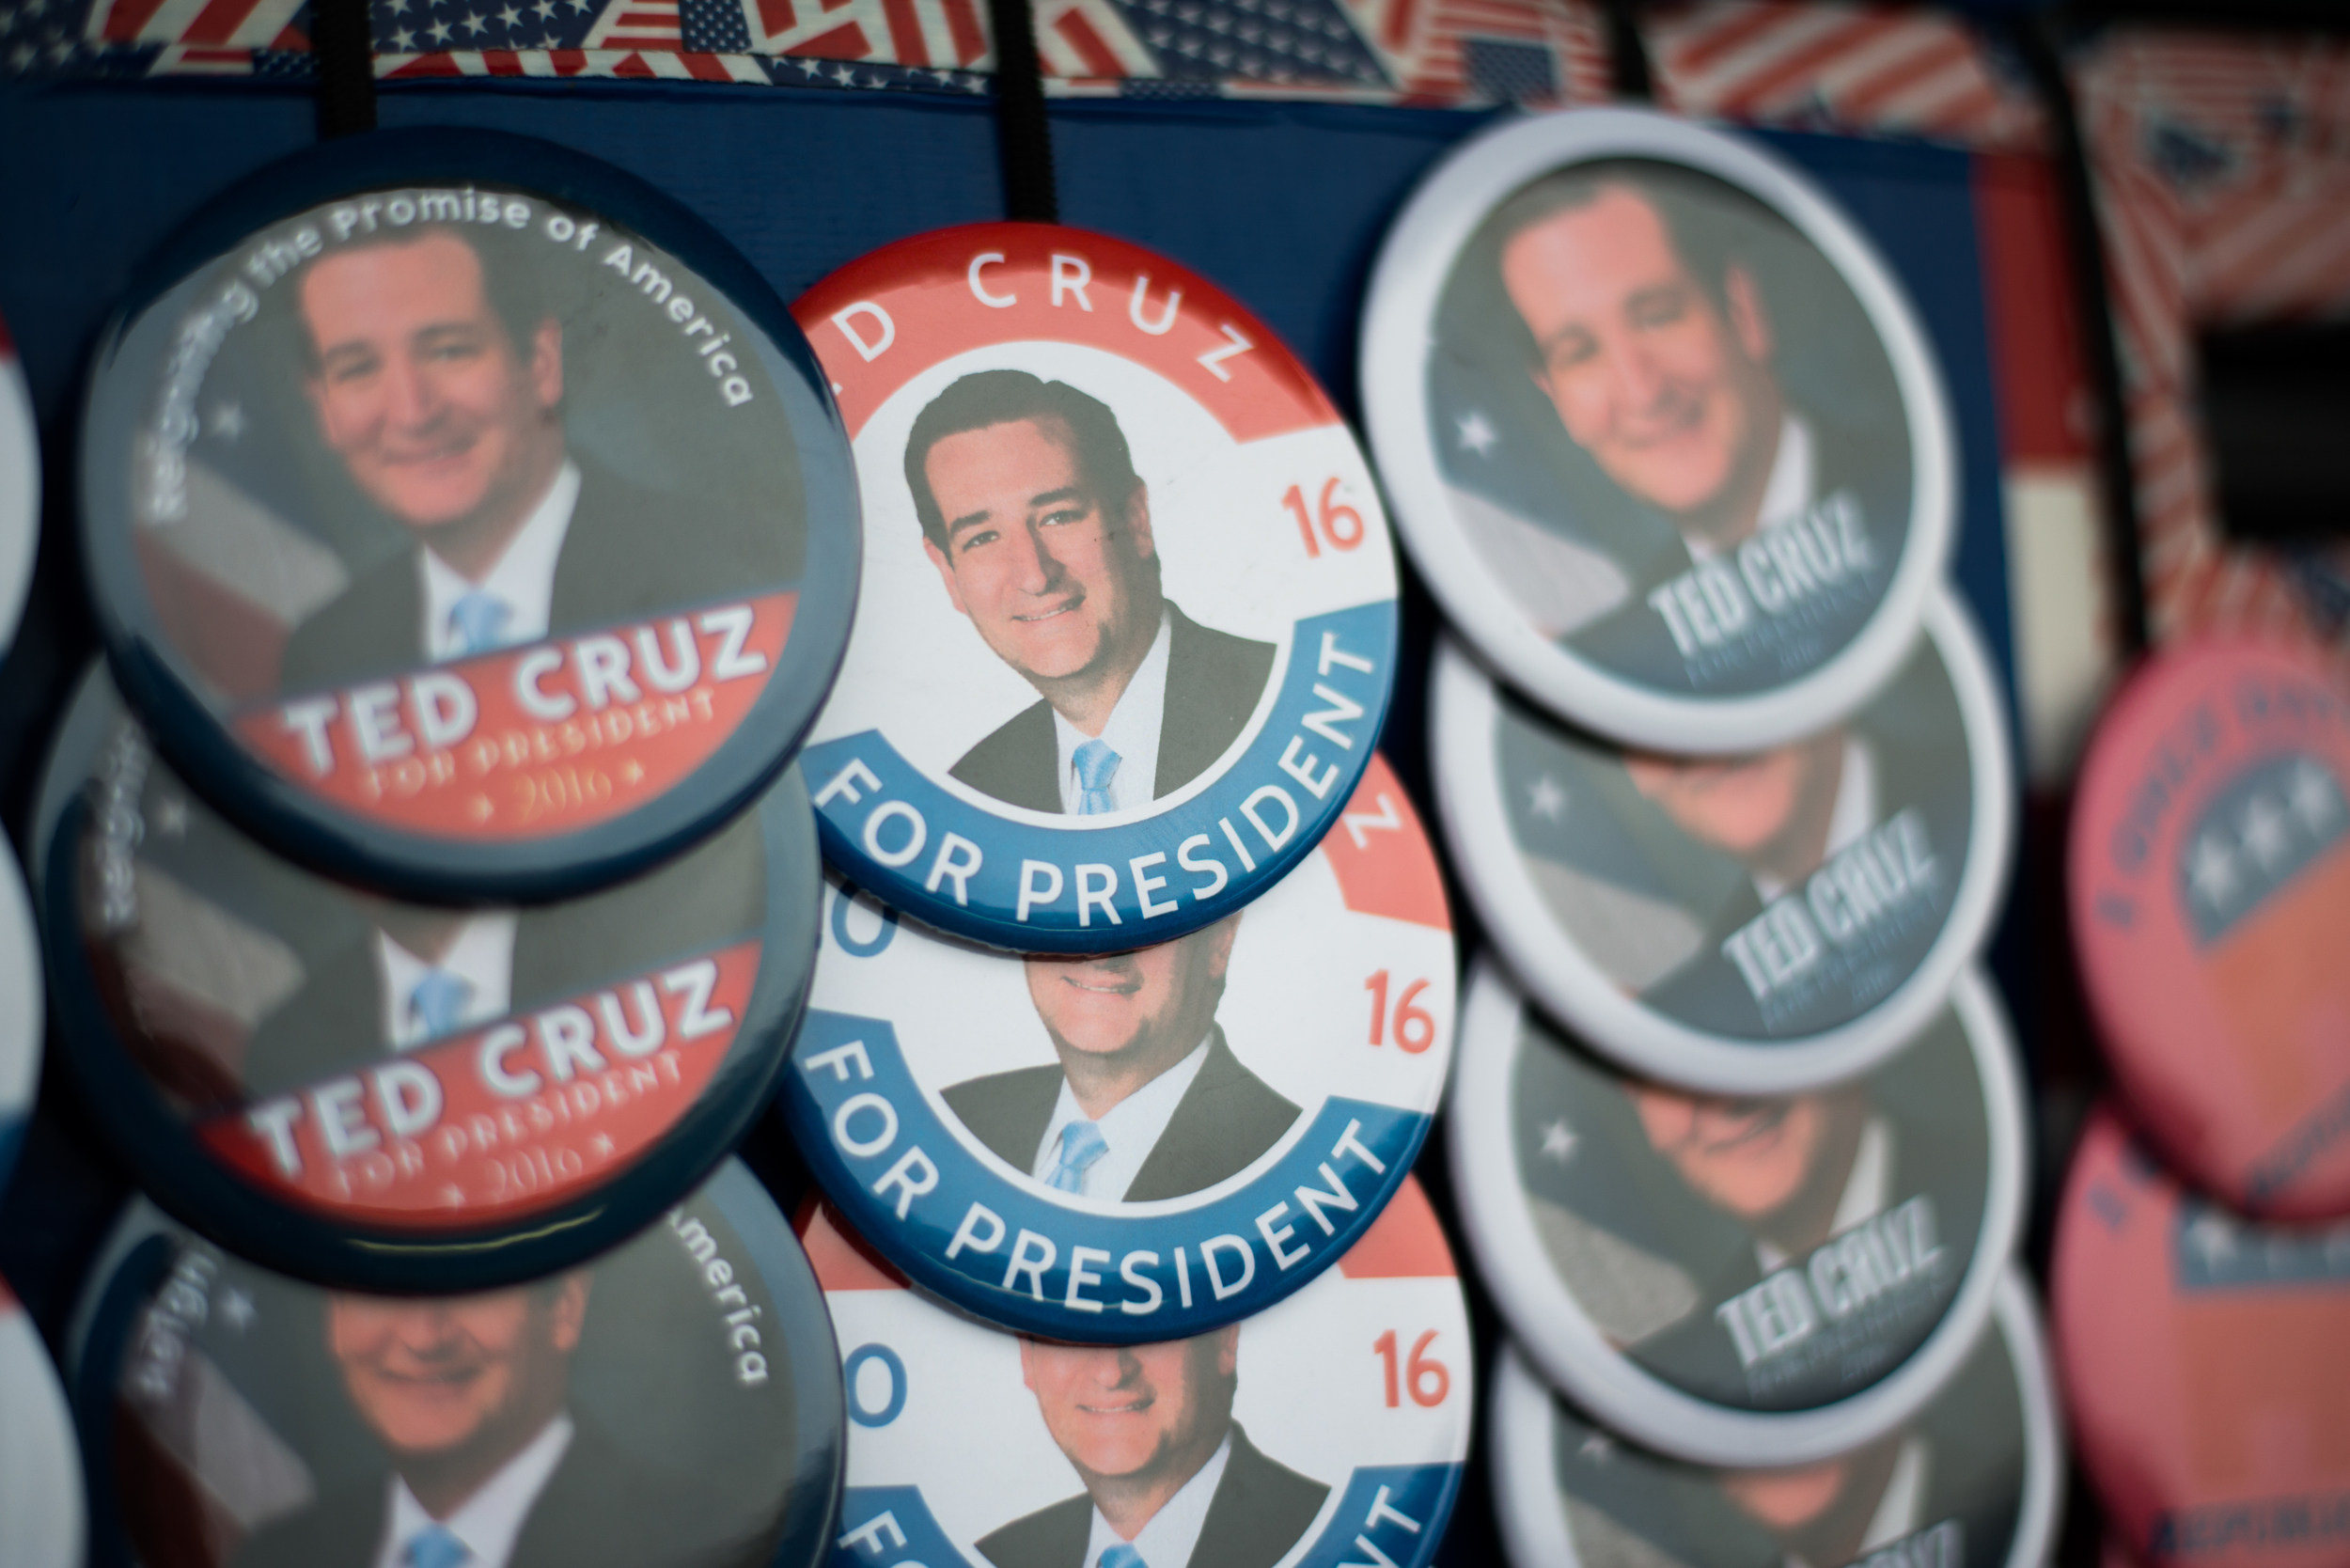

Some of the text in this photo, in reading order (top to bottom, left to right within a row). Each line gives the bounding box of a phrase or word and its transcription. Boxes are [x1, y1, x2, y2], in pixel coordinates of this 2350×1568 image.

[246, 227, 323, 288] the
[331, 187, 532, 241] Promise
[545, 213, 600, 252] of
[603, 243, 754, 407] America
[831, 252, 1256, 396] D CRUZ
[1281, 476, 1366, 559] 16
[1647, 561, 1750, 660] TED
[1737, 494, 1874, 617] CRUZ
[283, 604, 768, 778] TED CRUZ
[355, 688, 717, 804] FOR PRESIDENT
[814, 631, 1374, 927] FOR PRESIDENT
[1720, 895, 1821, 999] TED
[1806, 804, 1941, 941] CRUZ
[248, 959, 733, 1181] TED CRUZ
[1363, 969, 1435, 1055] 16
[323, 1048, 682, 1202] FOR PRESIDENT
[804, 1039, 1386, 1315] FOR PRESIDENT
[1714, 1266, 1816, 1367] TED
[1806, 1193, 1951, 1318] CRUZ
[1371, 1328, 1451, 1410] 16
